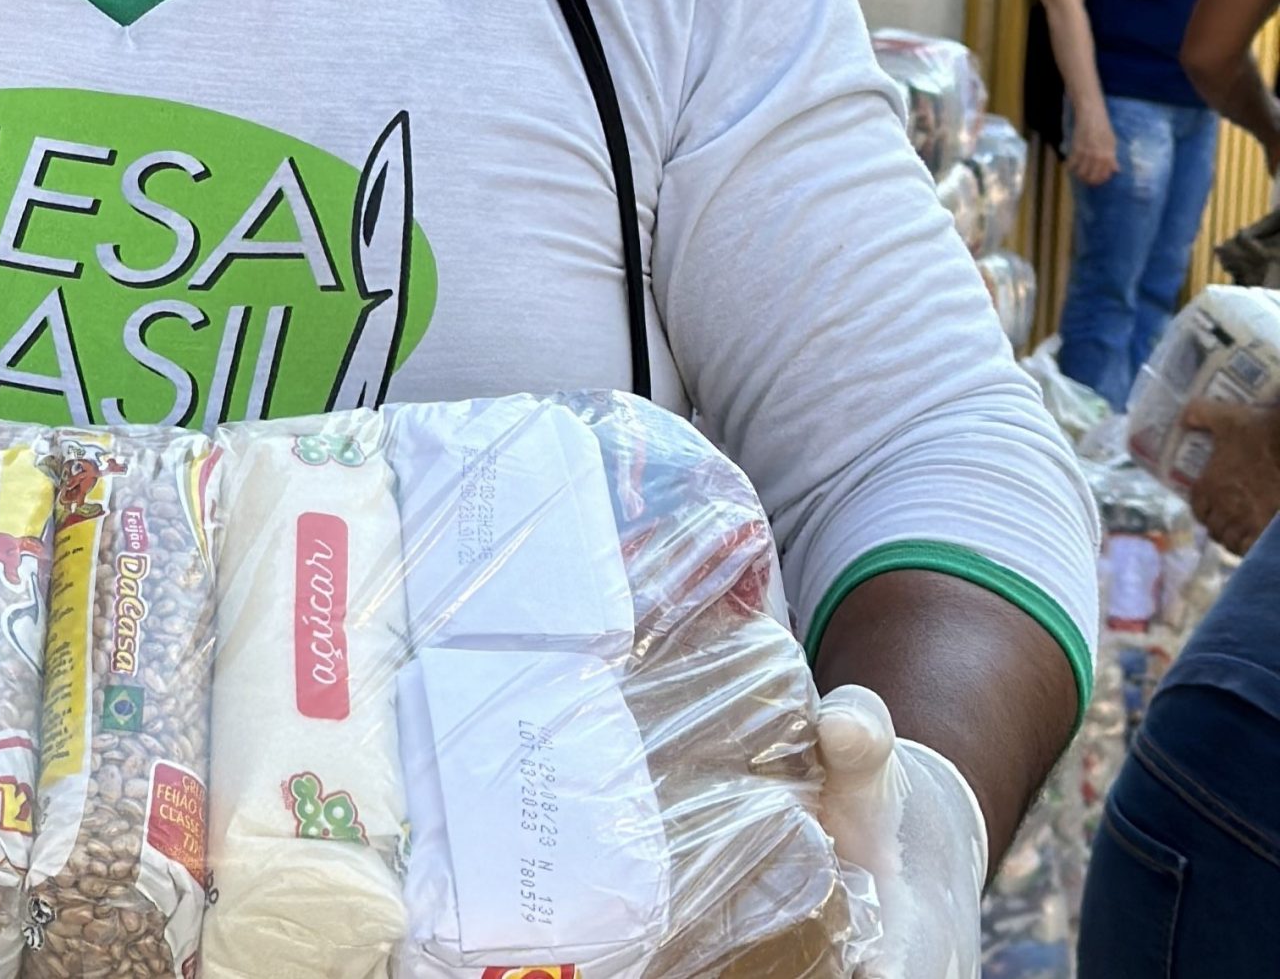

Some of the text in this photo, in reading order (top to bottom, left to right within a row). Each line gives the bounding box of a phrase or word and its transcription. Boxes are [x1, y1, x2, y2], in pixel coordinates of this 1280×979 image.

[123, 510, 142, 551] Feijão
[111, 552, 150, 676] DaCasa
[304, 538, 343, 685] açúcar
[518, 720, 535, 751] LOT
[519, 857, 536, 923] 780579
[537, 894, 554, 925] 131
